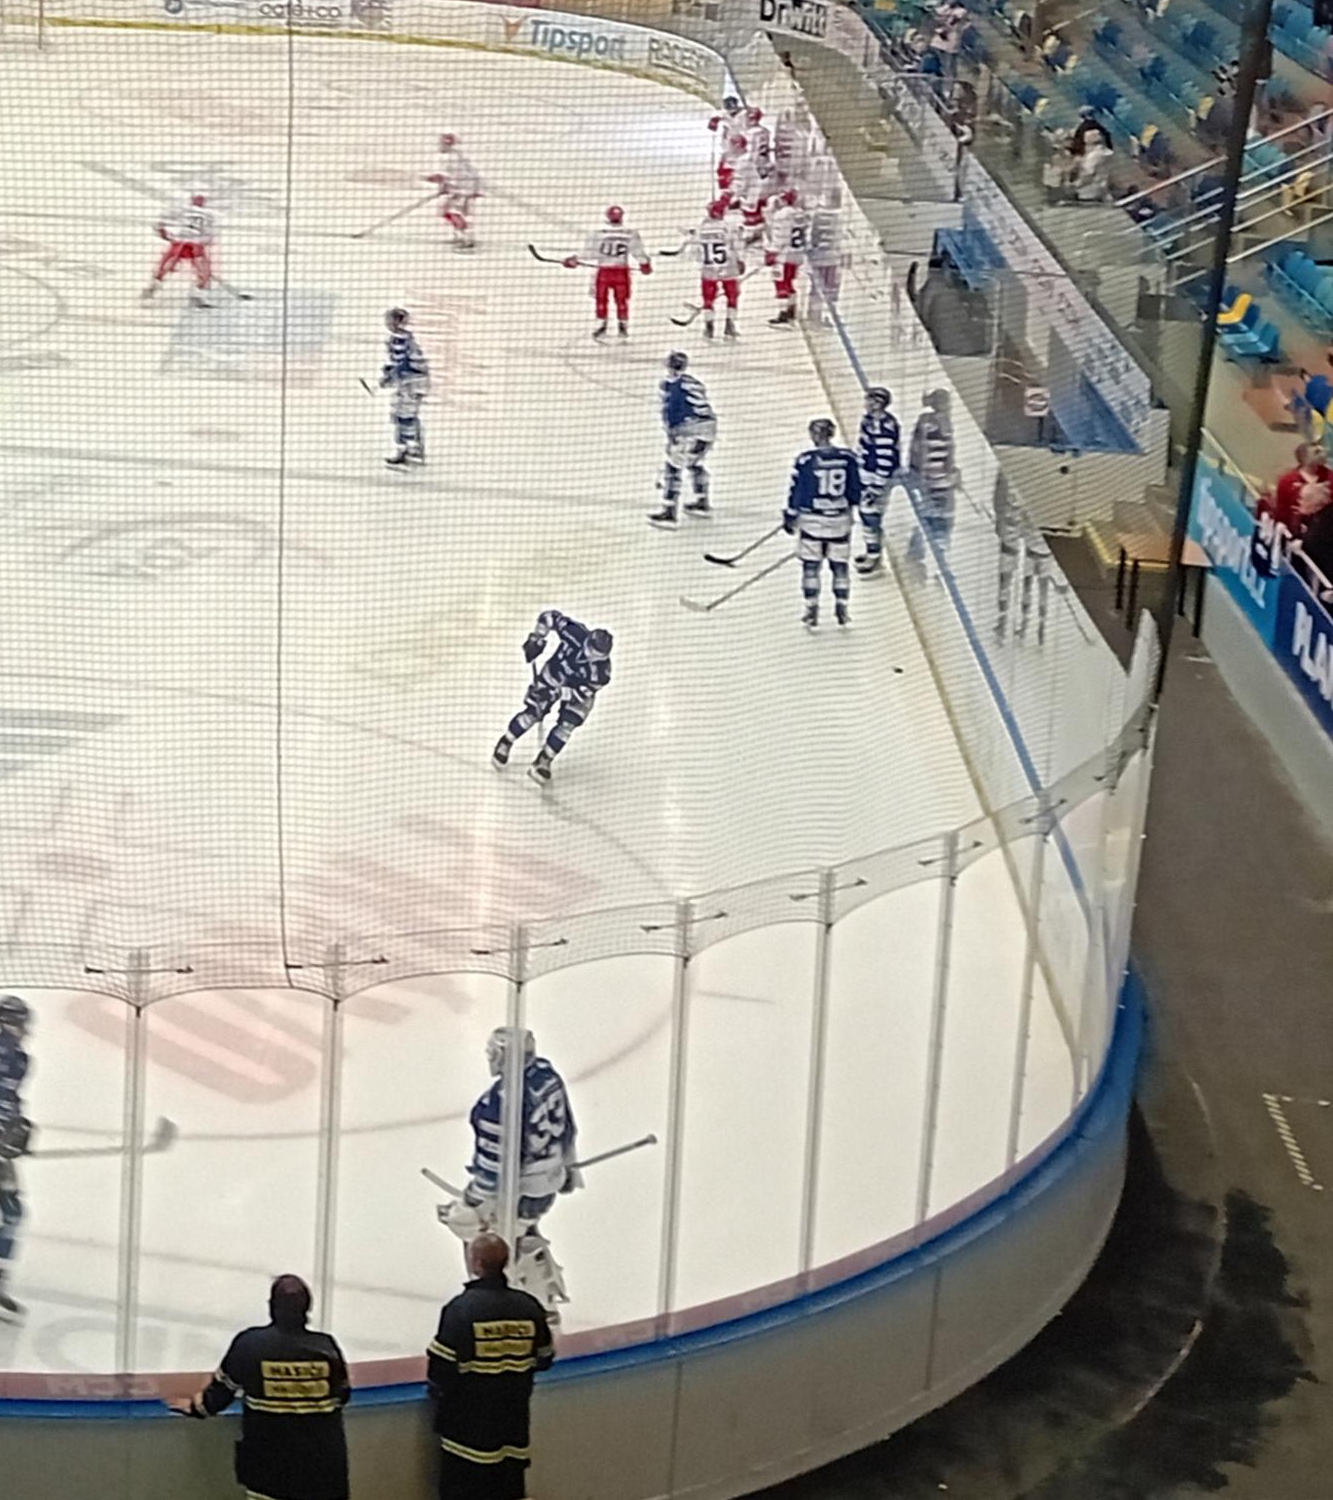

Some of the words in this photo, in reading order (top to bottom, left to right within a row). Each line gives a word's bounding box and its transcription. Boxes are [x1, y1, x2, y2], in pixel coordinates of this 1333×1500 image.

[529, 19, 627, 59] Tipsport
[702, 242, 728, 266] 15
[813, 468, 847, 496] 18
